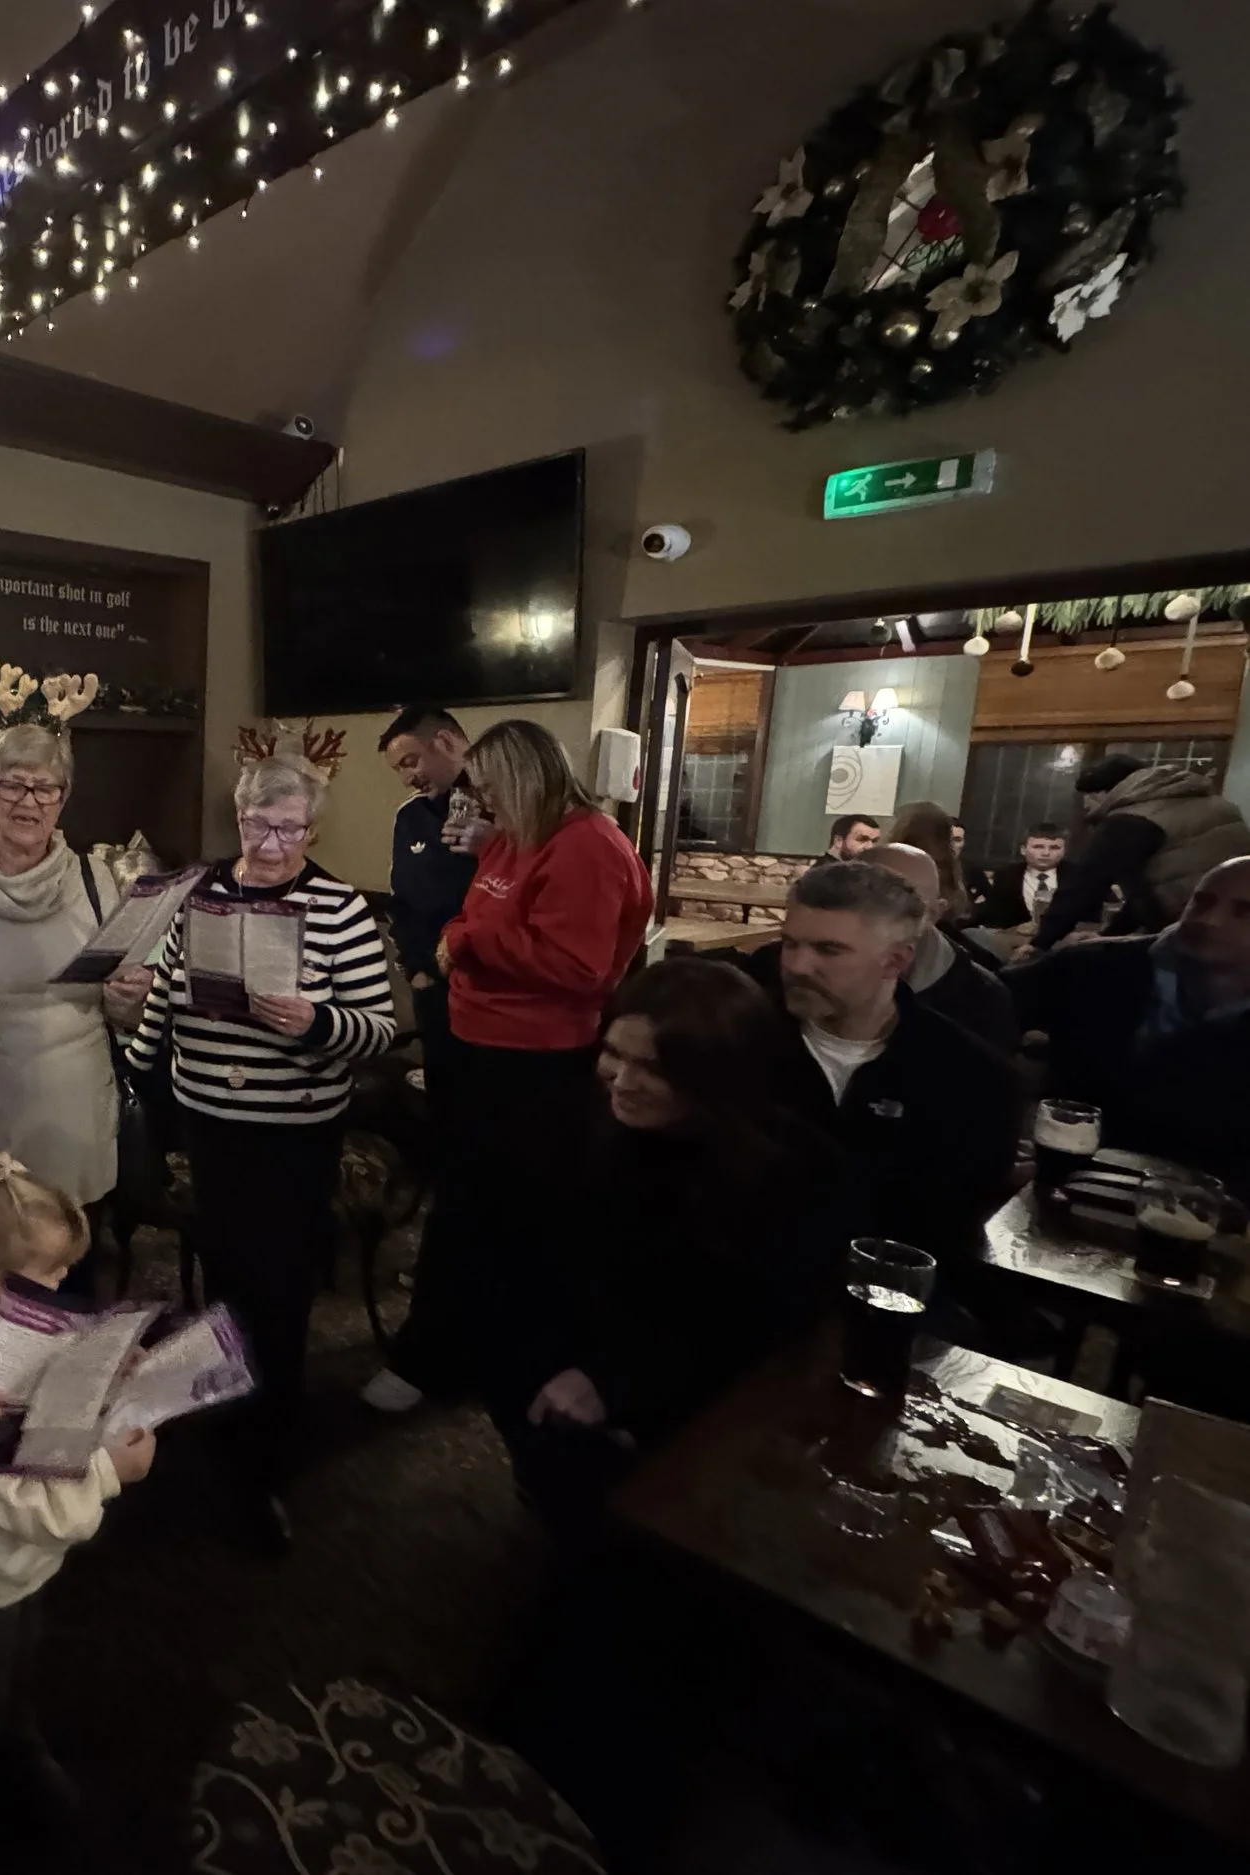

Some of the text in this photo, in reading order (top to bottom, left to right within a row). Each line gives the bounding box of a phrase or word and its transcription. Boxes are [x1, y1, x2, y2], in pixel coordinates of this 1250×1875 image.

[123, 50, 150, 100] to
[163, 12, 200, 67] be
[58, 583, 86, 603] shot
[89, 590, 103, 604] in
[106, 591, 131, 609] golf
[22, 615, 37, 632] is
[39, 615, 60, 636] the
[63, 621, 92, 637] next
